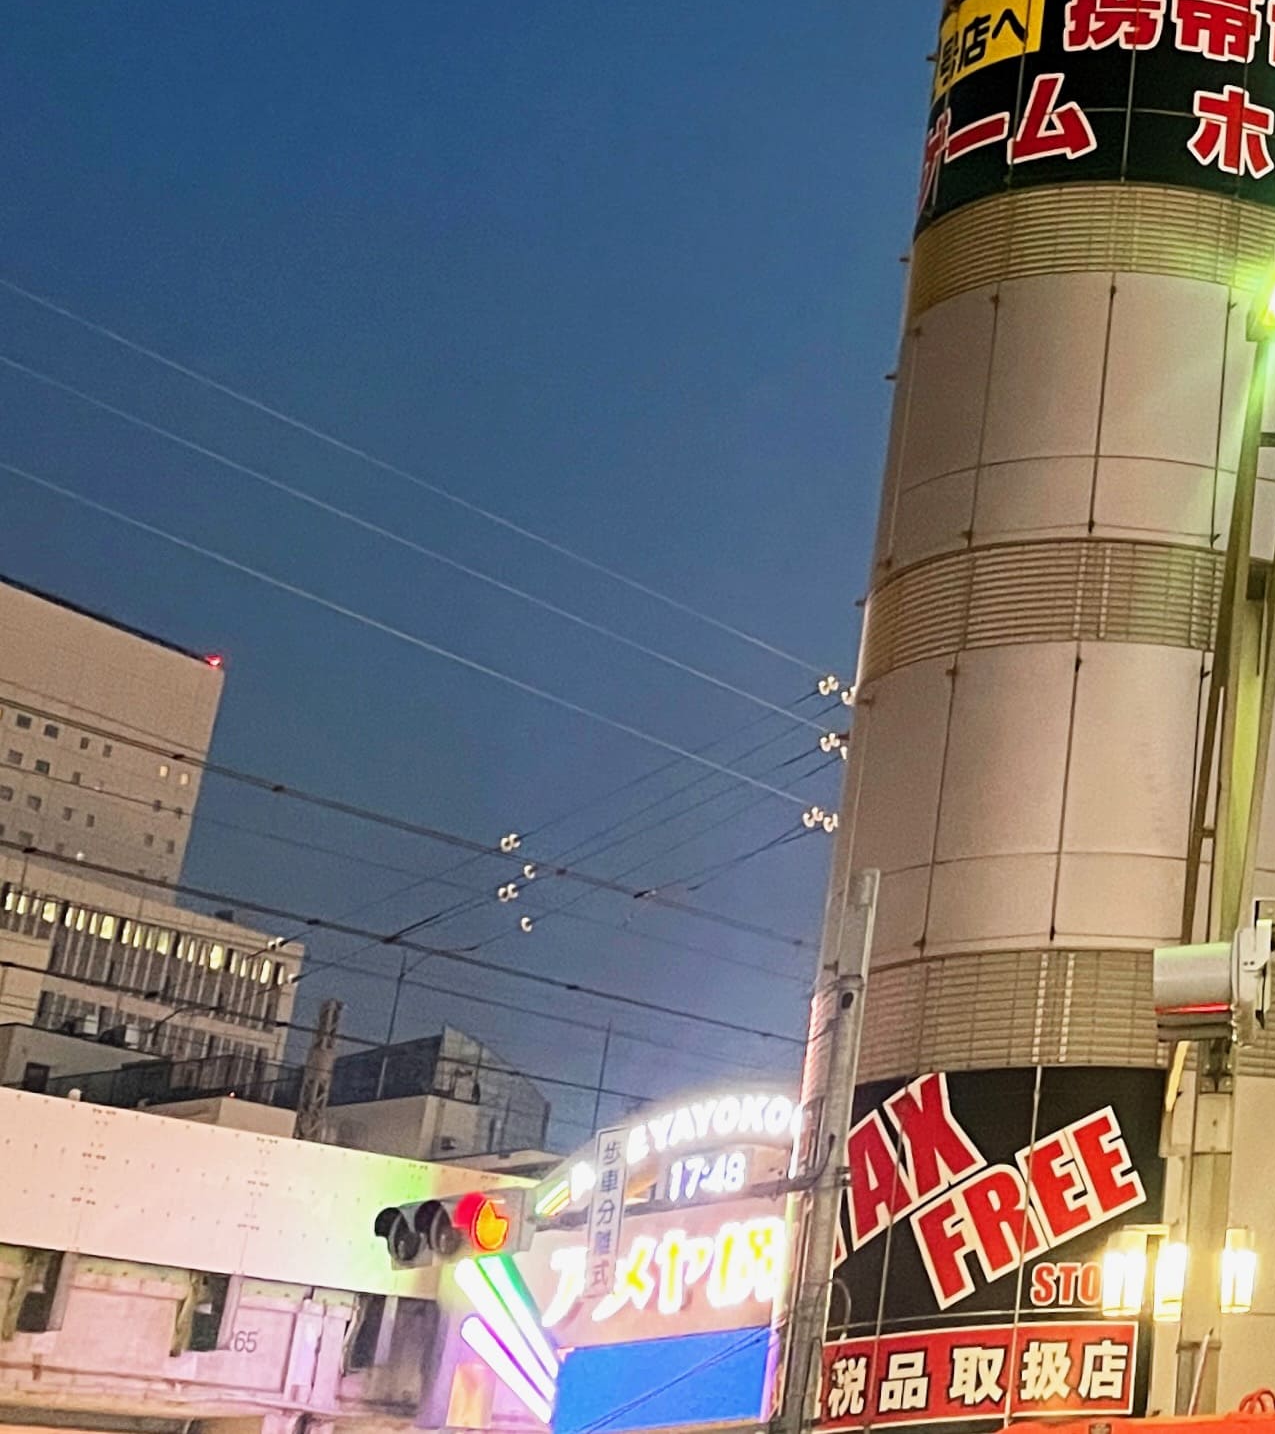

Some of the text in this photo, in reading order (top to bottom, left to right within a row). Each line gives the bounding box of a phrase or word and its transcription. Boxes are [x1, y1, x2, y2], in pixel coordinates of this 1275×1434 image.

[833, 1072, 987, 1269] AX
[910, 1105, 1147, 1311] FREE
[820, 1339, 1130, 1419] 税品取扱店
